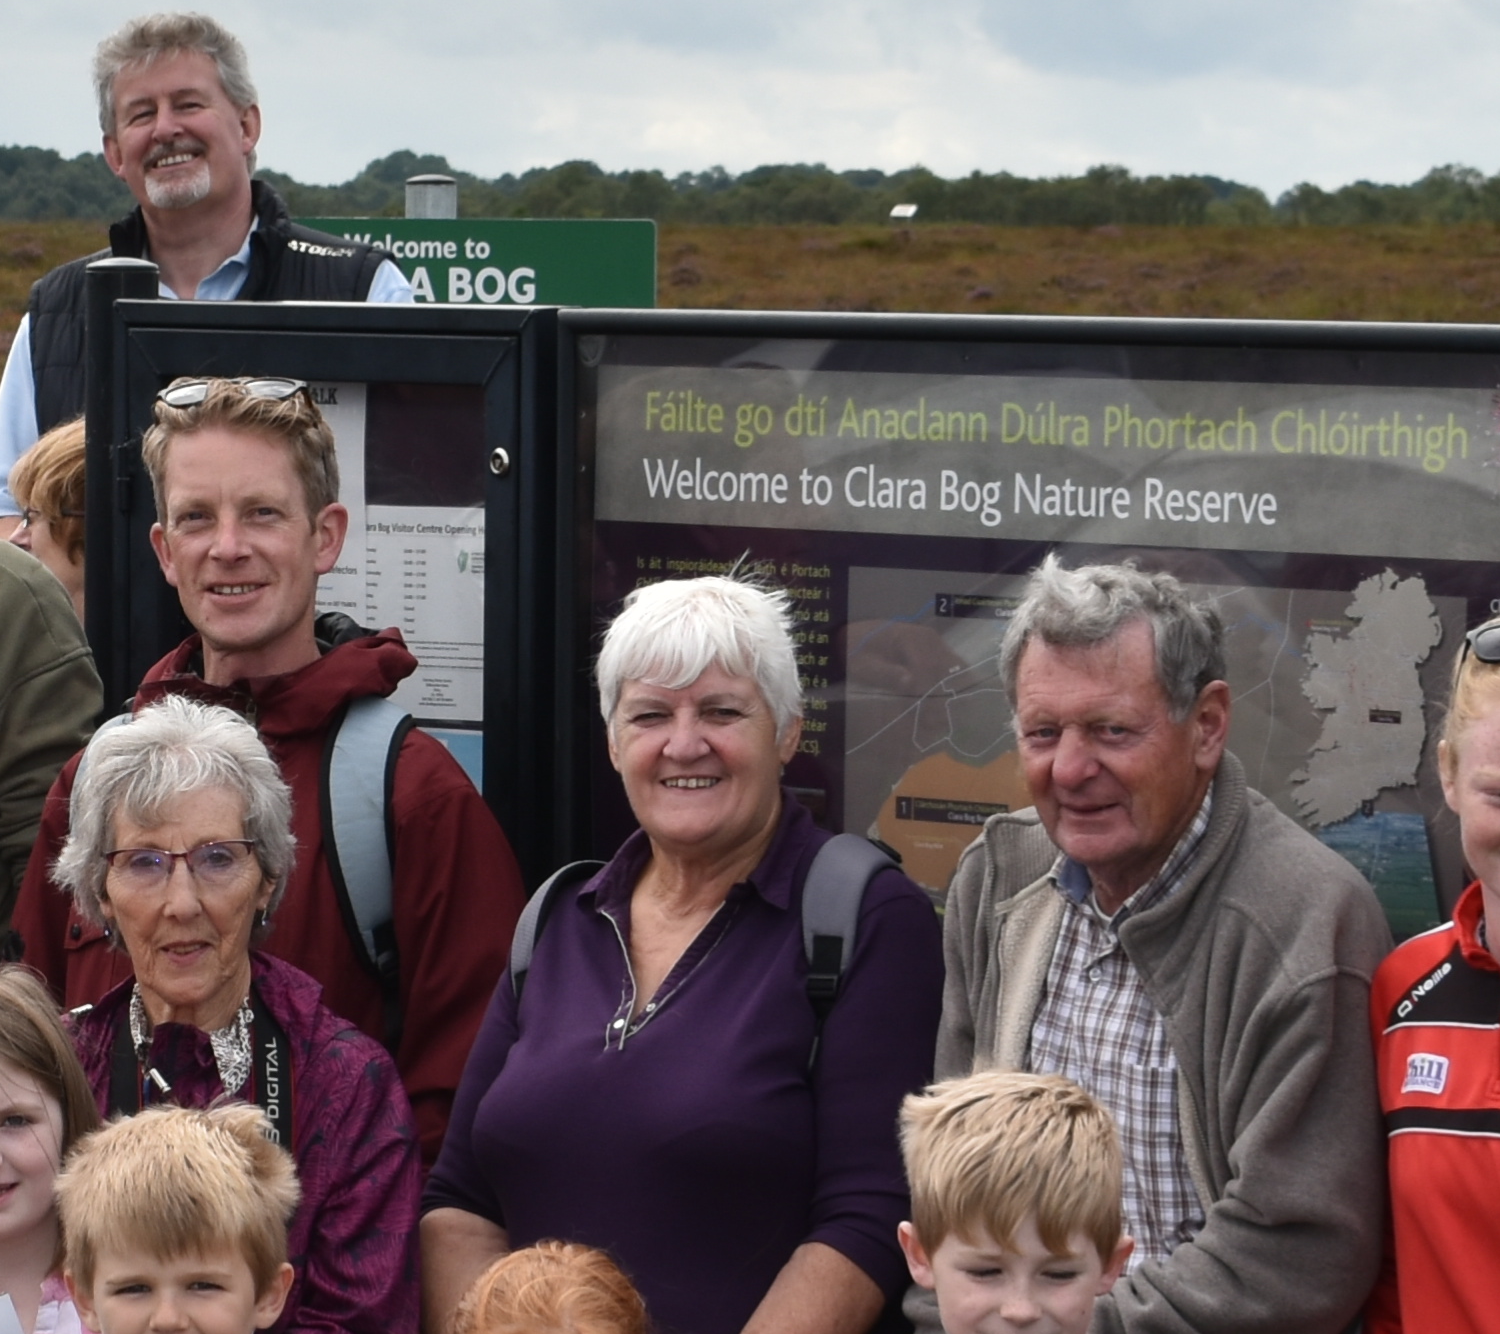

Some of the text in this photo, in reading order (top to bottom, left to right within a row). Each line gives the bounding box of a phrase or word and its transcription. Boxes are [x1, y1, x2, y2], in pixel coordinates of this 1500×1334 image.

[465, 237, 491, 260] to
[448, 267, 536, 305] BOG
[645, 389, 1469, 473] Fáilte go dtí Anaclann Dúlra Phortach Chlóirthigh
[643, 457, 1278, 527] Welcome to Clara Bog Nature Reserve
[416, 523, 443, 535] Centre
[444, 525, 477, 537] Opening
[265, 1037, 279, 1119] DIGITAL
[1407, 1057, 1445, 1082] hill
